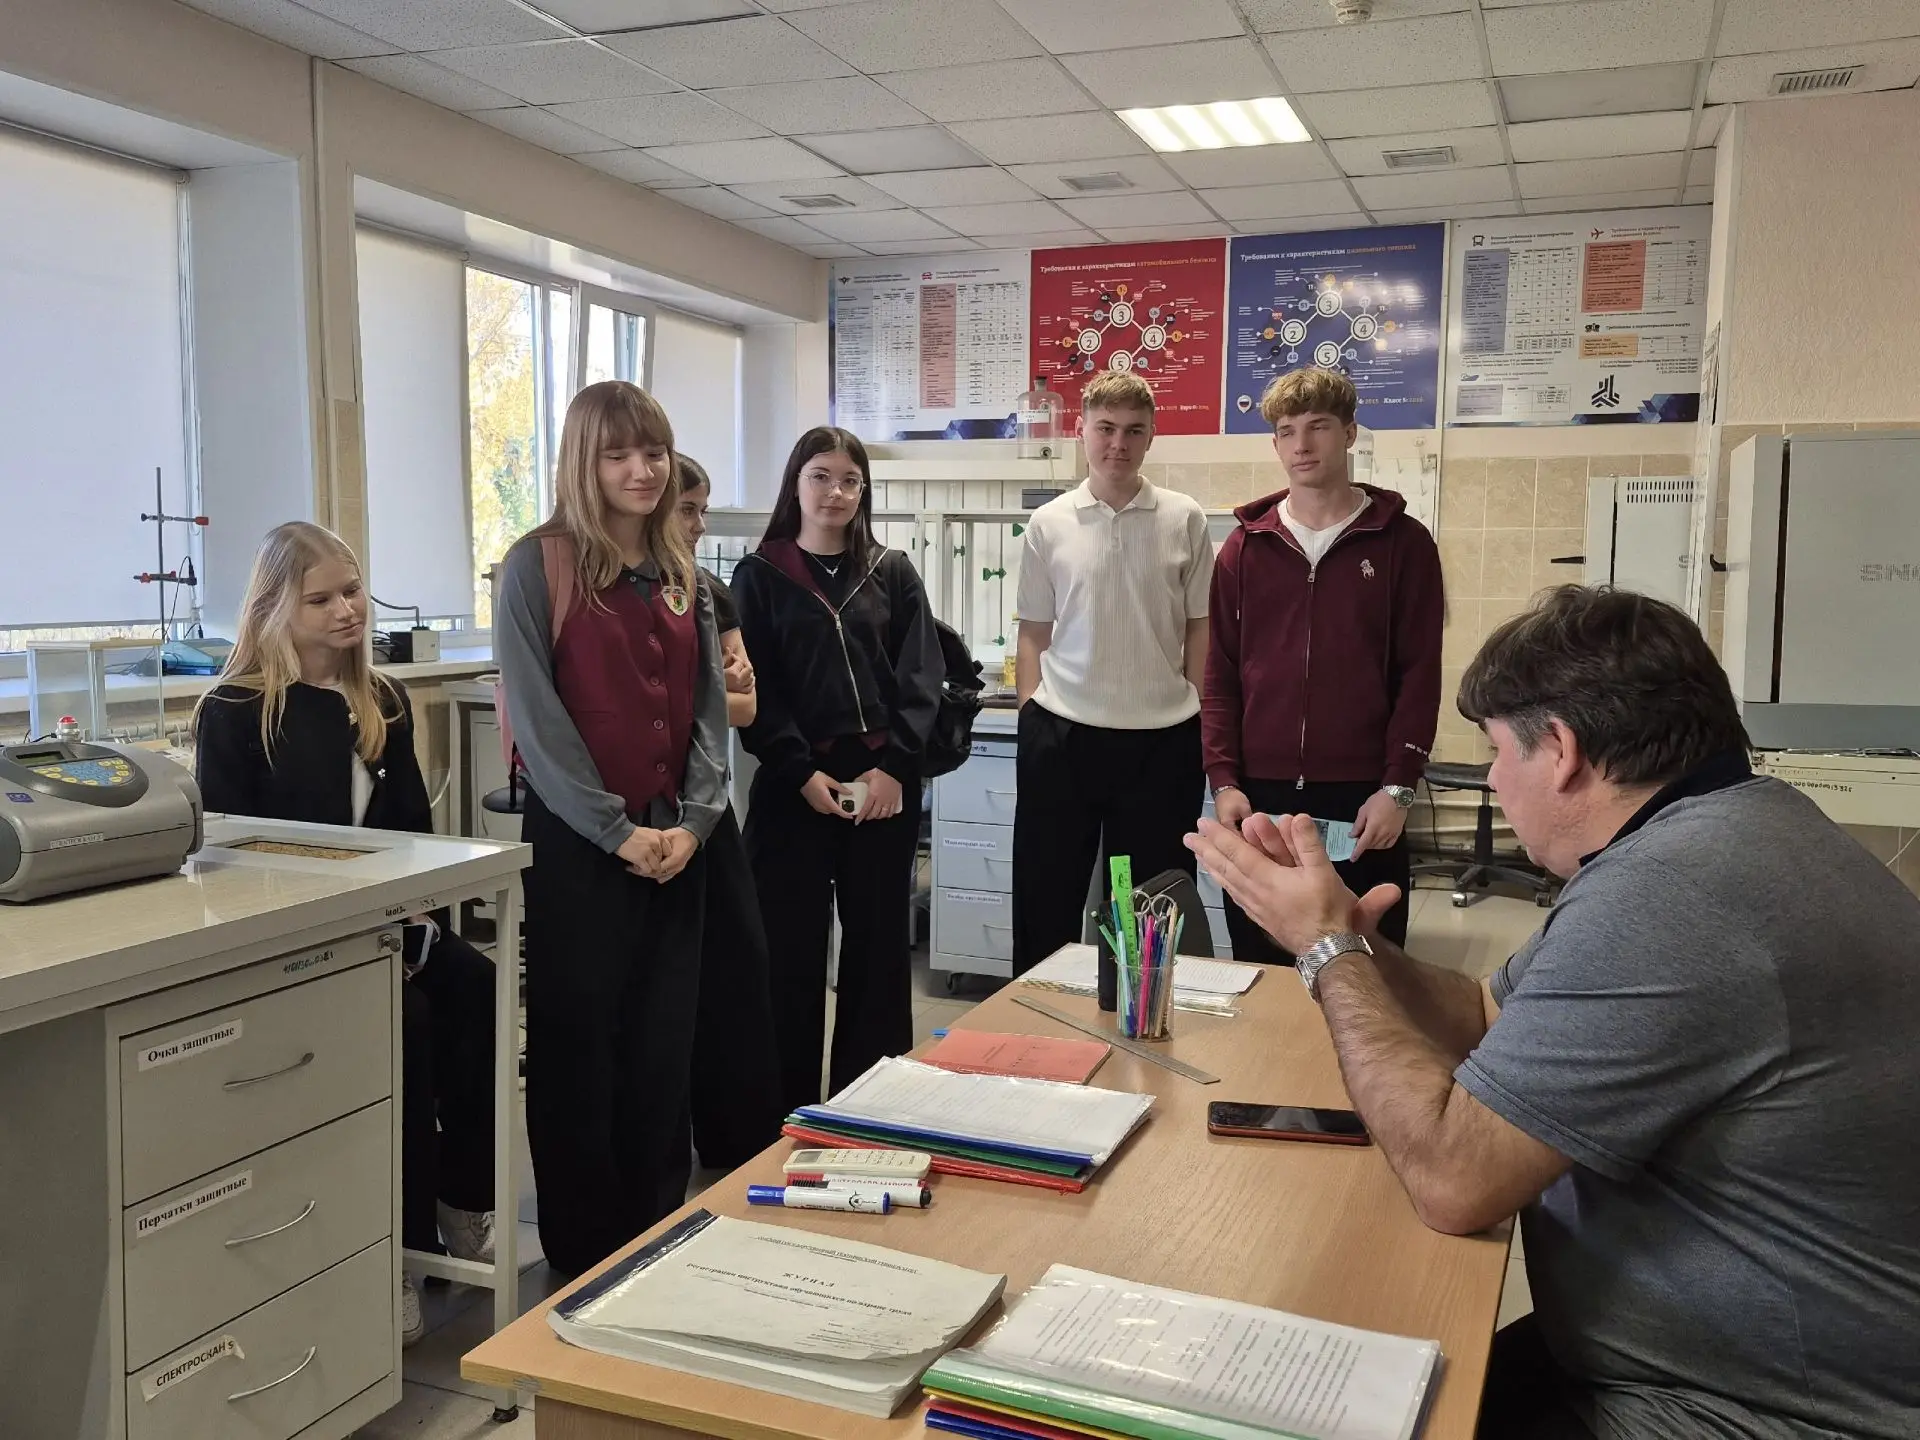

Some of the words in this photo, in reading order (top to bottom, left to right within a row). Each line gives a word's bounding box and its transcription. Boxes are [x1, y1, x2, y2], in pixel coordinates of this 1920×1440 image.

[1240, 253, 1280, 262] Требования
[1286, 248, 1346, 260] характеристикам
[1040, 265, 1076, 274] Требования
[1082, 262, 1136, 272] характеристикам
[1325, 300, 1332, 312] 3
[1118, 311, 1125, 321] 3
[1290, 330, 1297, 340] 2
[1359, 325, 1368, 335] 4
[1086, 339, 1093, 349] 2
[1149, 334, 1156, 344] 4
[1324, 352, 1330, 363] 5
[1118, 360, 1124, 371] 5
[147, 1045, 179, 1062] Очки
[181, 1026, 235, 1052] защитные
[137, 1200, 193, 1231] Перчатки
[194, 1177, 248, 1207] защитные
[156, 1341, 226, 1387] СПЕКТРОСКАН
